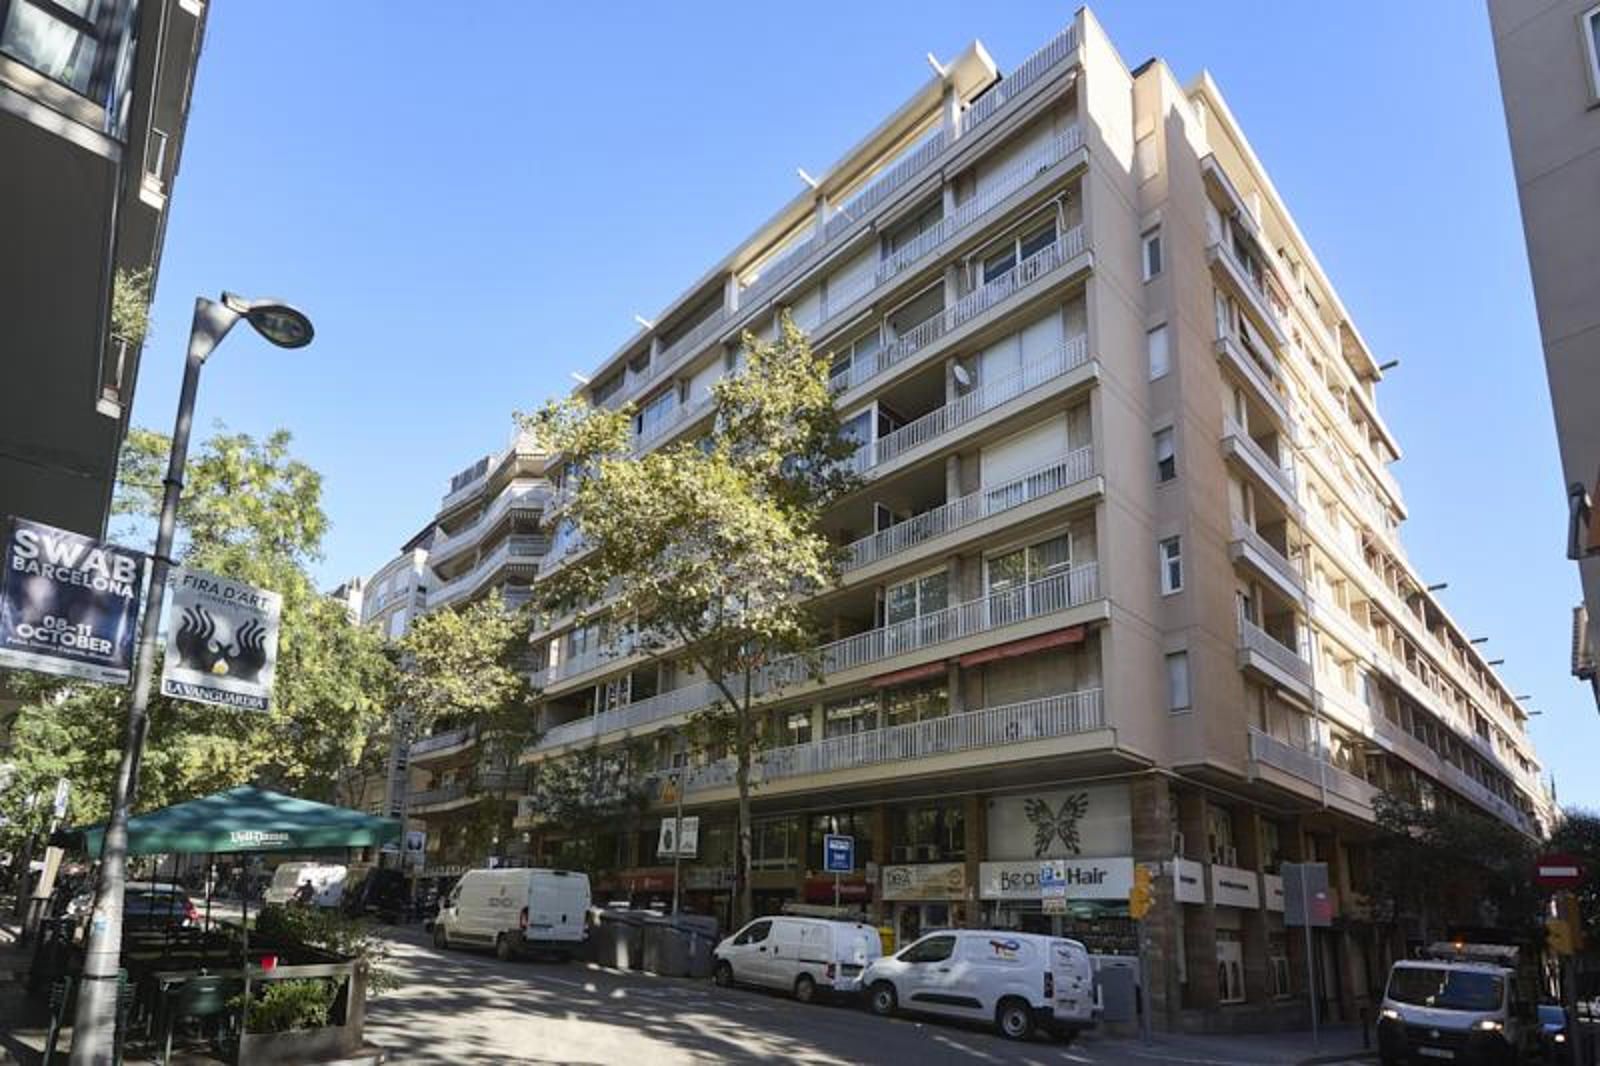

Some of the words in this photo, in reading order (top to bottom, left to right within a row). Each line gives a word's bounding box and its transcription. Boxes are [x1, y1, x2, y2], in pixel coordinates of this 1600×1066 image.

[13, 529, 136, 582] SWAB
[13, 556, 134, 599] BARCELONA
[183, 575, 219, 595] FIRA
[16, 623, 112, 655] OCTOBER
[1067, 866, 1107, 885] Hair
